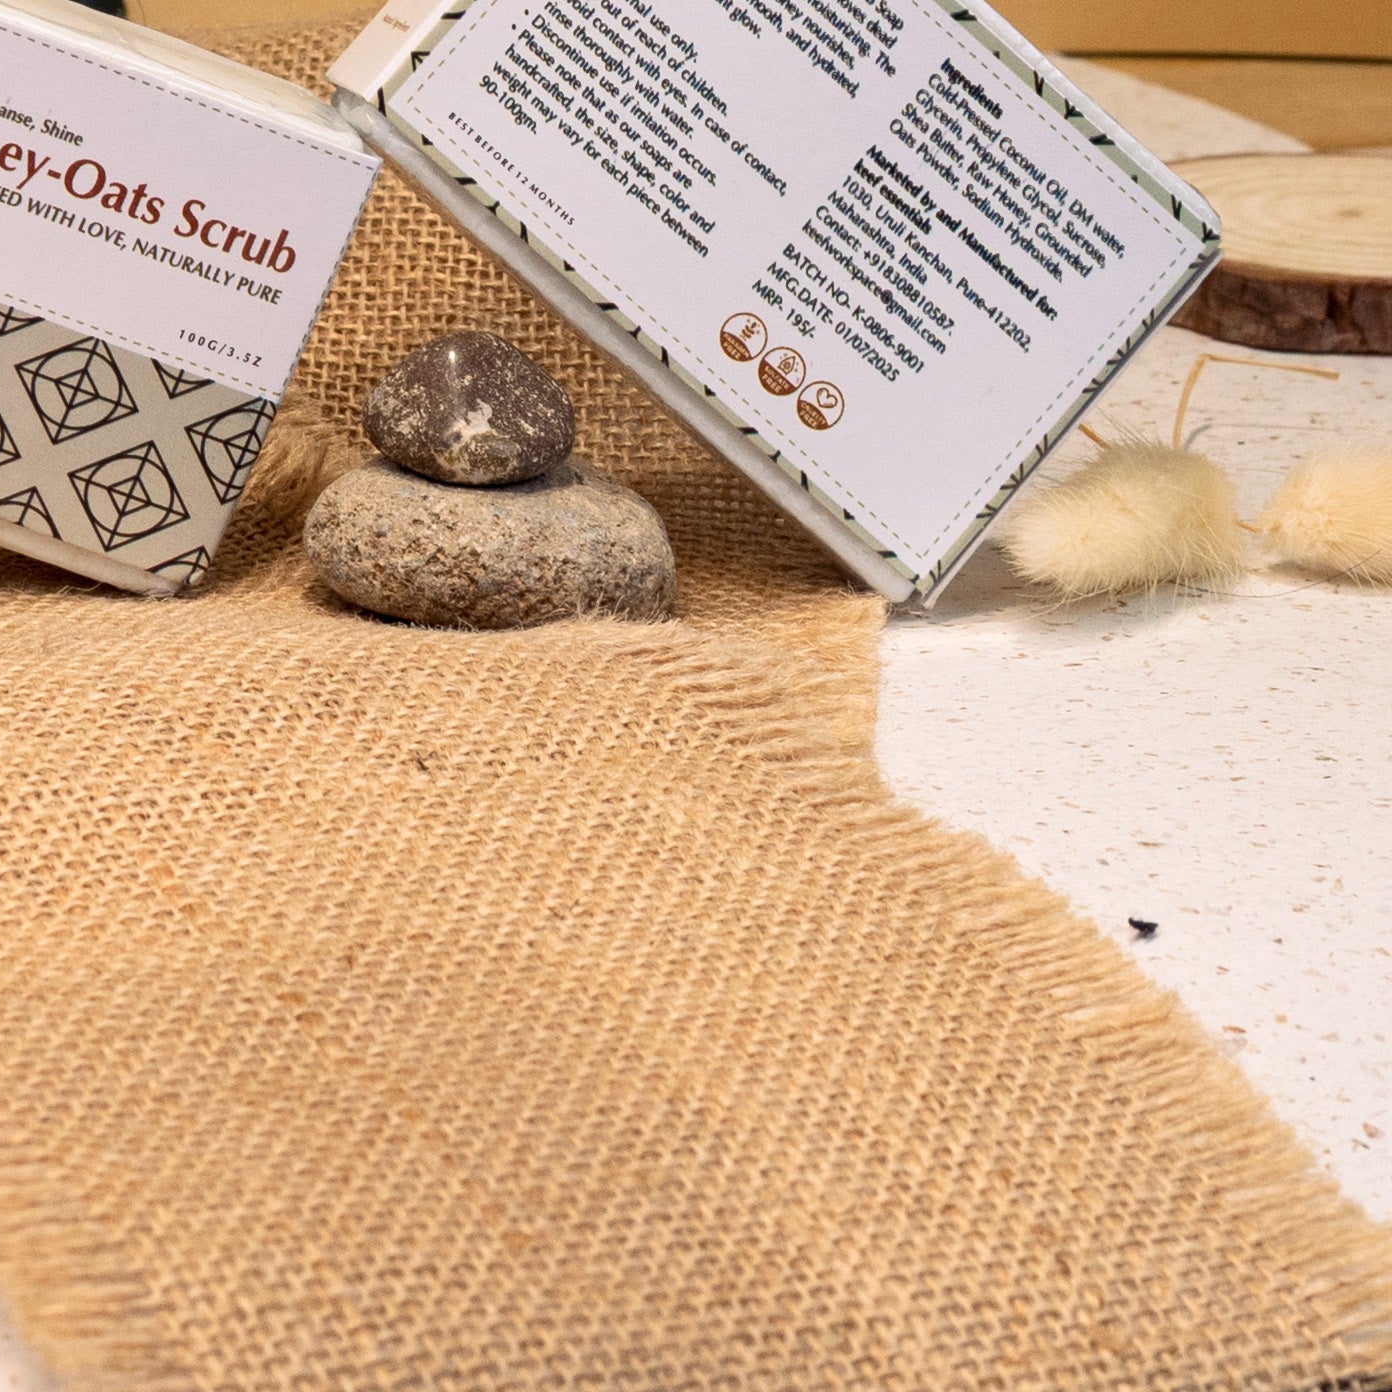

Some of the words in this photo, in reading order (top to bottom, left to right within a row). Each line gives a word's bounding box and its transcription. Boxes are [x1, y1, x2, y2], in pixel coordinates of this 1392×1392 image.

[649, 14, 671, 37] use
[670, 33, 698, 63] only.
[729, 7, 762, 39] glow.
[785, 28, 812, 52] and
[808, 44, 860, 99] hydrated,
[802, 16, 855, 70] nourishes,
[866, 19, 898, 50] dead
[875, 0, 904, 31] Soap
[517, 29, 555, 67] Please
[554, 64, 582, 91] note
[581, 86, 606, 112] that
[604, 109, 620, 125] as
[619, 121, 642, 142] our
[639, 139, 673, 172] soaps
[672, 169, 693, 190] are
[531, 14, 599, 79] Discontinue
[599, 76, 620, 98] use
[619, 92, 635, 107] if
[630, 101, 678, 150] irritation
[678, 147, 716, 187] occurs.
[544, 1, 573, 30] rinse
[572, 25, 635, 84] thoroughly
[634, 80, 660, 108] with
[661, 103, 694, 140] water.
[592, 17, 636, 58] contact
[635, 54, 661, 82] with
[661, 78, 688, 108] eyes.
[690, 102, 704, 120] In
[704, 117, 731, 143] case
[730, 140, 749, 155] of
[744, 152, 787, 197] contact,
[621, 16, 639, 31] of
[634, 27, 667, 61] reach
[667, 57, 686, 72] of
[681, 69, 727, 117] children.
[875, 50, 896, 78] The
[940, 57, 1003, 120] Ingredients
[40, 118, 84, 147] Shine
[448, 112, 474, 136] BEST
[474, 134, 515, 172] BEFORE
[515, 171, 529, 185] 12
[529, 183, 575, 226] MONTHS
[493, 61, 532, 100] weight
[530, 96, 558, 123] may
[558, 119, 584, 146] vary
[582, 140, 602, 160] for
[600, 158, 629, 187] each
[626, 183, 661, 215] piece
[660, 208, 709, 258] between
[504, 43, 575, 113] handcrafted,
[574, 106, 595, 129] the
[594, 126, 619, 155] size,
[621, 150, 656, 187] shape,
[659, 183, 691, 213] color
[689, 210, 716, 234] and
[928, 73, 1002, 144] Cold-Pressed
[999, 136, 1047, 185] Coconut
[1046, 179, 1069, 207] Oil,
[1068, 199, 1094, 227] DM
[1092, 222, 1125, 259] water,
[173, 199, 296, 273] Scrub
[816, 205, 862, 253] Contact:
[827, 190, 895, 260] Maharashtra,
[898, 252, 928, 286] India
[853, 158, 884, 188] keef
[879, 184, 932, 235] essentials
[866, 144, 924, 199] Marketed
[919, 190, 937, 213] by
[935, 208, 962, 233] and
[957, 227, 1039, 302] Manufactured
[1035, 295, 1058, 322] for:
[875, 204, 907, 237] Uruli
[904, 230, 953, 284] Kanchan,
[27, 197, 76, 228] WITH
[78, 217, 127, 251] LOVE,
[132, 237, 236, 287] NATURALLY
[236, 276, 283, 305] PURE
[802, 218, 946, 355] keefworkspace@gmail.com
[751, 279, 783, 311] MRP-
[786, 308, 816, 339] 195/-
[766, 261, 833, 325] MFG.DATE-
[834, 321, 900, 382] 01/07/2025
[782, 243, 828, 287] BATCH
[825, 281, 851, 309] NO-
[852, 305, 925, 374] K-0806-9001
